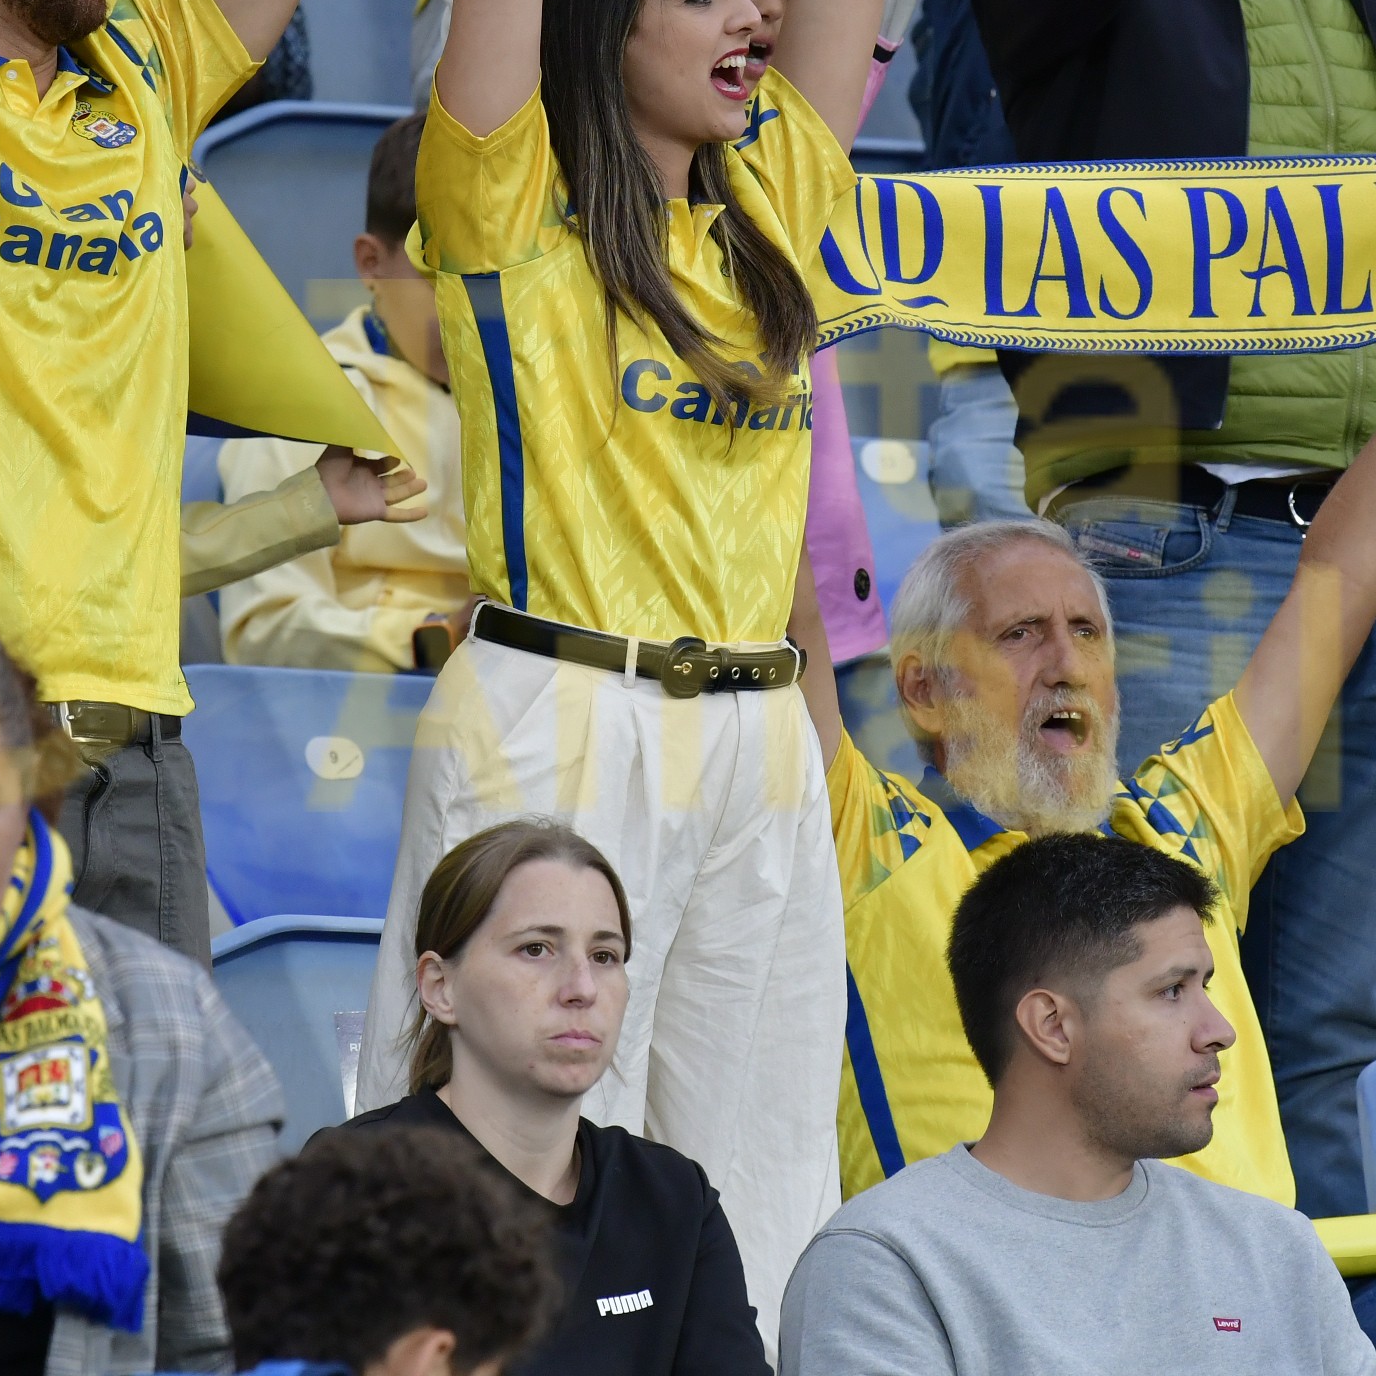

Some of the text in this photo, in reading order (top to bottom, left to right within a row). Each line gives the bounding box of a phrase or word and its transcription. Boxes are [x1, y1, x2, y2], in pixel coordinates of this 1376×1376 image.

[974, 185, 1154, 320] LAS
[620, 358, 813, 432] Canari
[596, 1289, 654, 1317] PUMA
